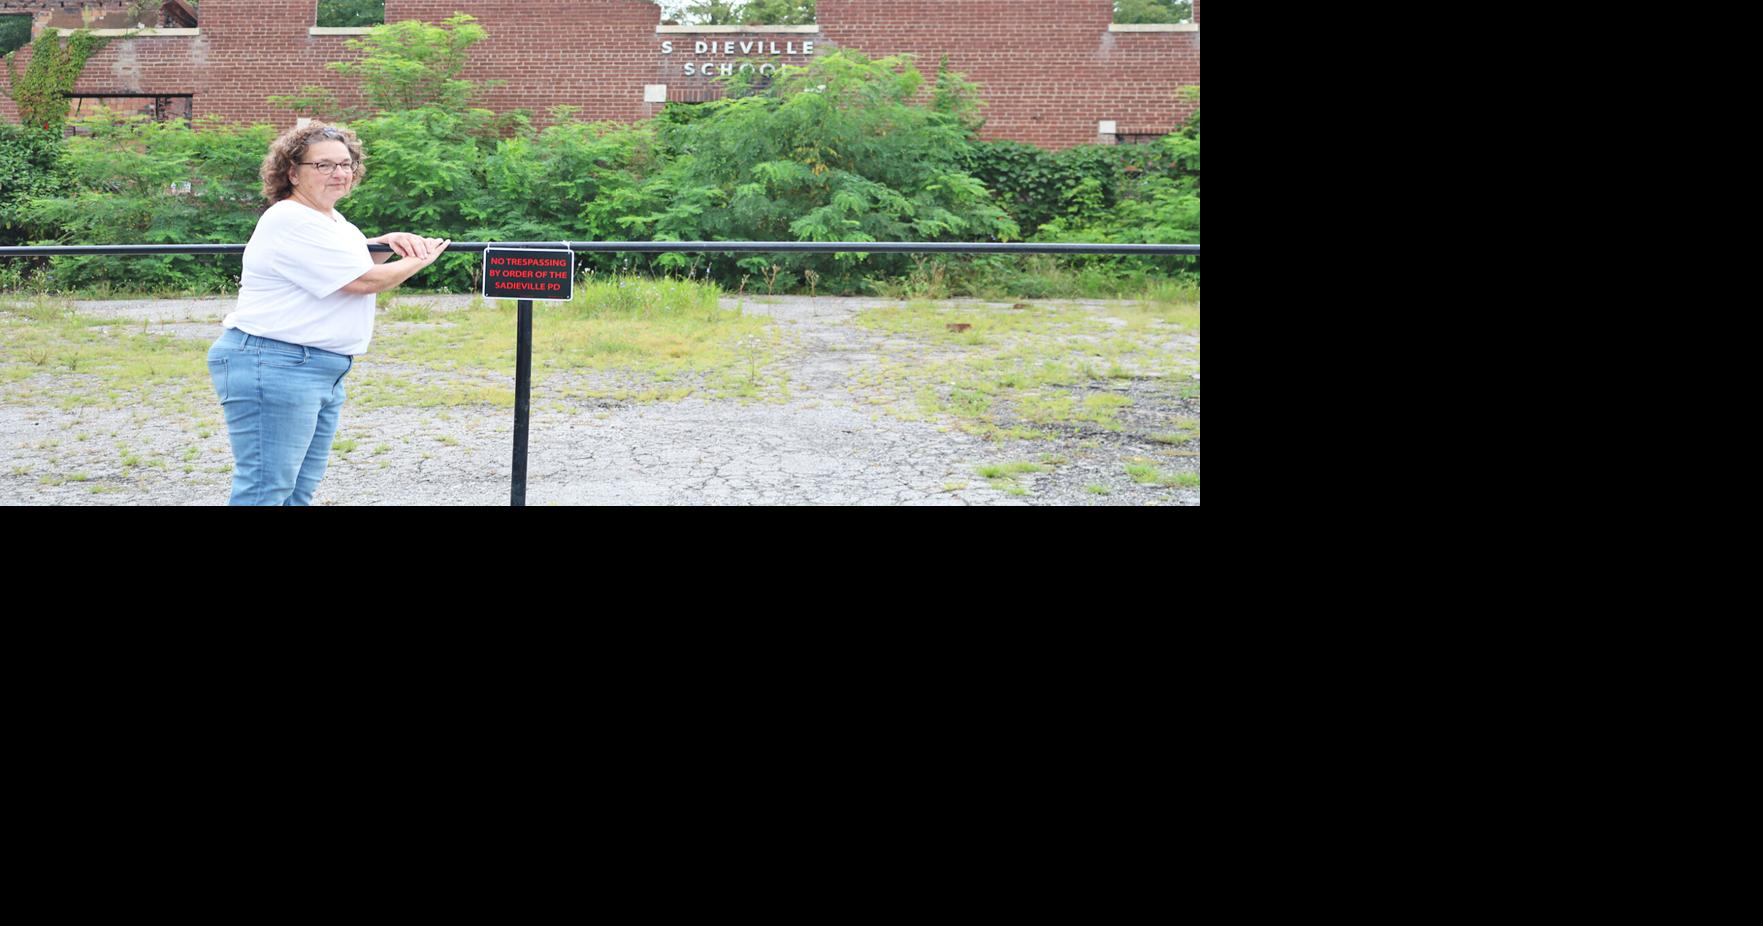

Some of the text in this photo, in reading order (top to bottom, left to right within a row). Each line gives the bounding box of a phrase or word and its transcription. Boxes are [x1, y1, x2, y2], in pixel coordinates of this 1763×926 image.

[491, 257, 567, 267] NO TRESPASSING
[489, 269, 501, 277] BY
[502, 270, 533, 278] ORDER
[549, 271, 568, 279] THE
[495, 282, 561, 291] SADIEVILLE PD
